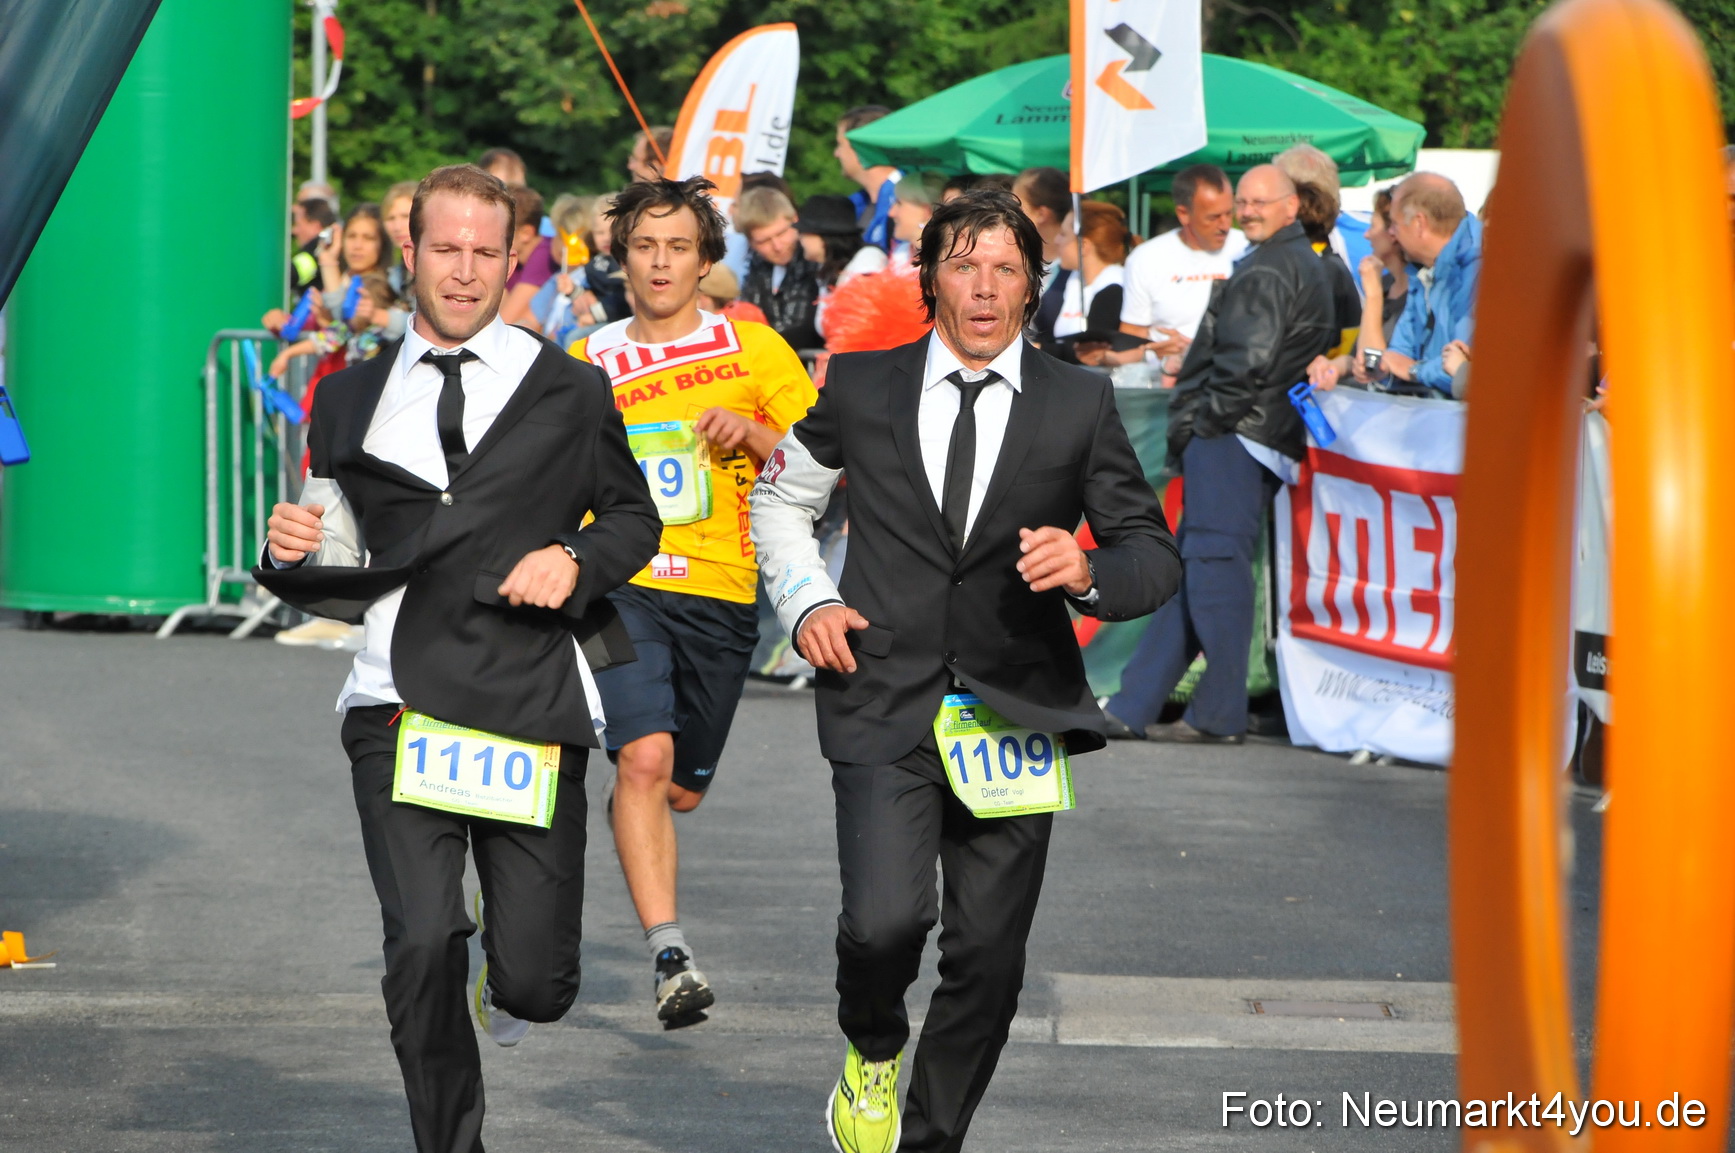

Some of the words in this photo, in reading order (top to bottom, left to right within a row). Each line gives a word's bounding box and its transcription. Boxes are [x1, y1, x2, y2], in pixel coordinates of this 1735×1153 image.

[996, 115, 1071, 124] Lamm
[702, 83, 757, 198] BL
[674, 362, 750, 391] BÖGL
[953, 717, 992, 730] firmenlauf
[408, 736, 533, 791] 1110
[949, 732, 1053, 784] 1109
[419, 779, 471, 798] Andreas
[981, 787, 1009, 799] Dieter
